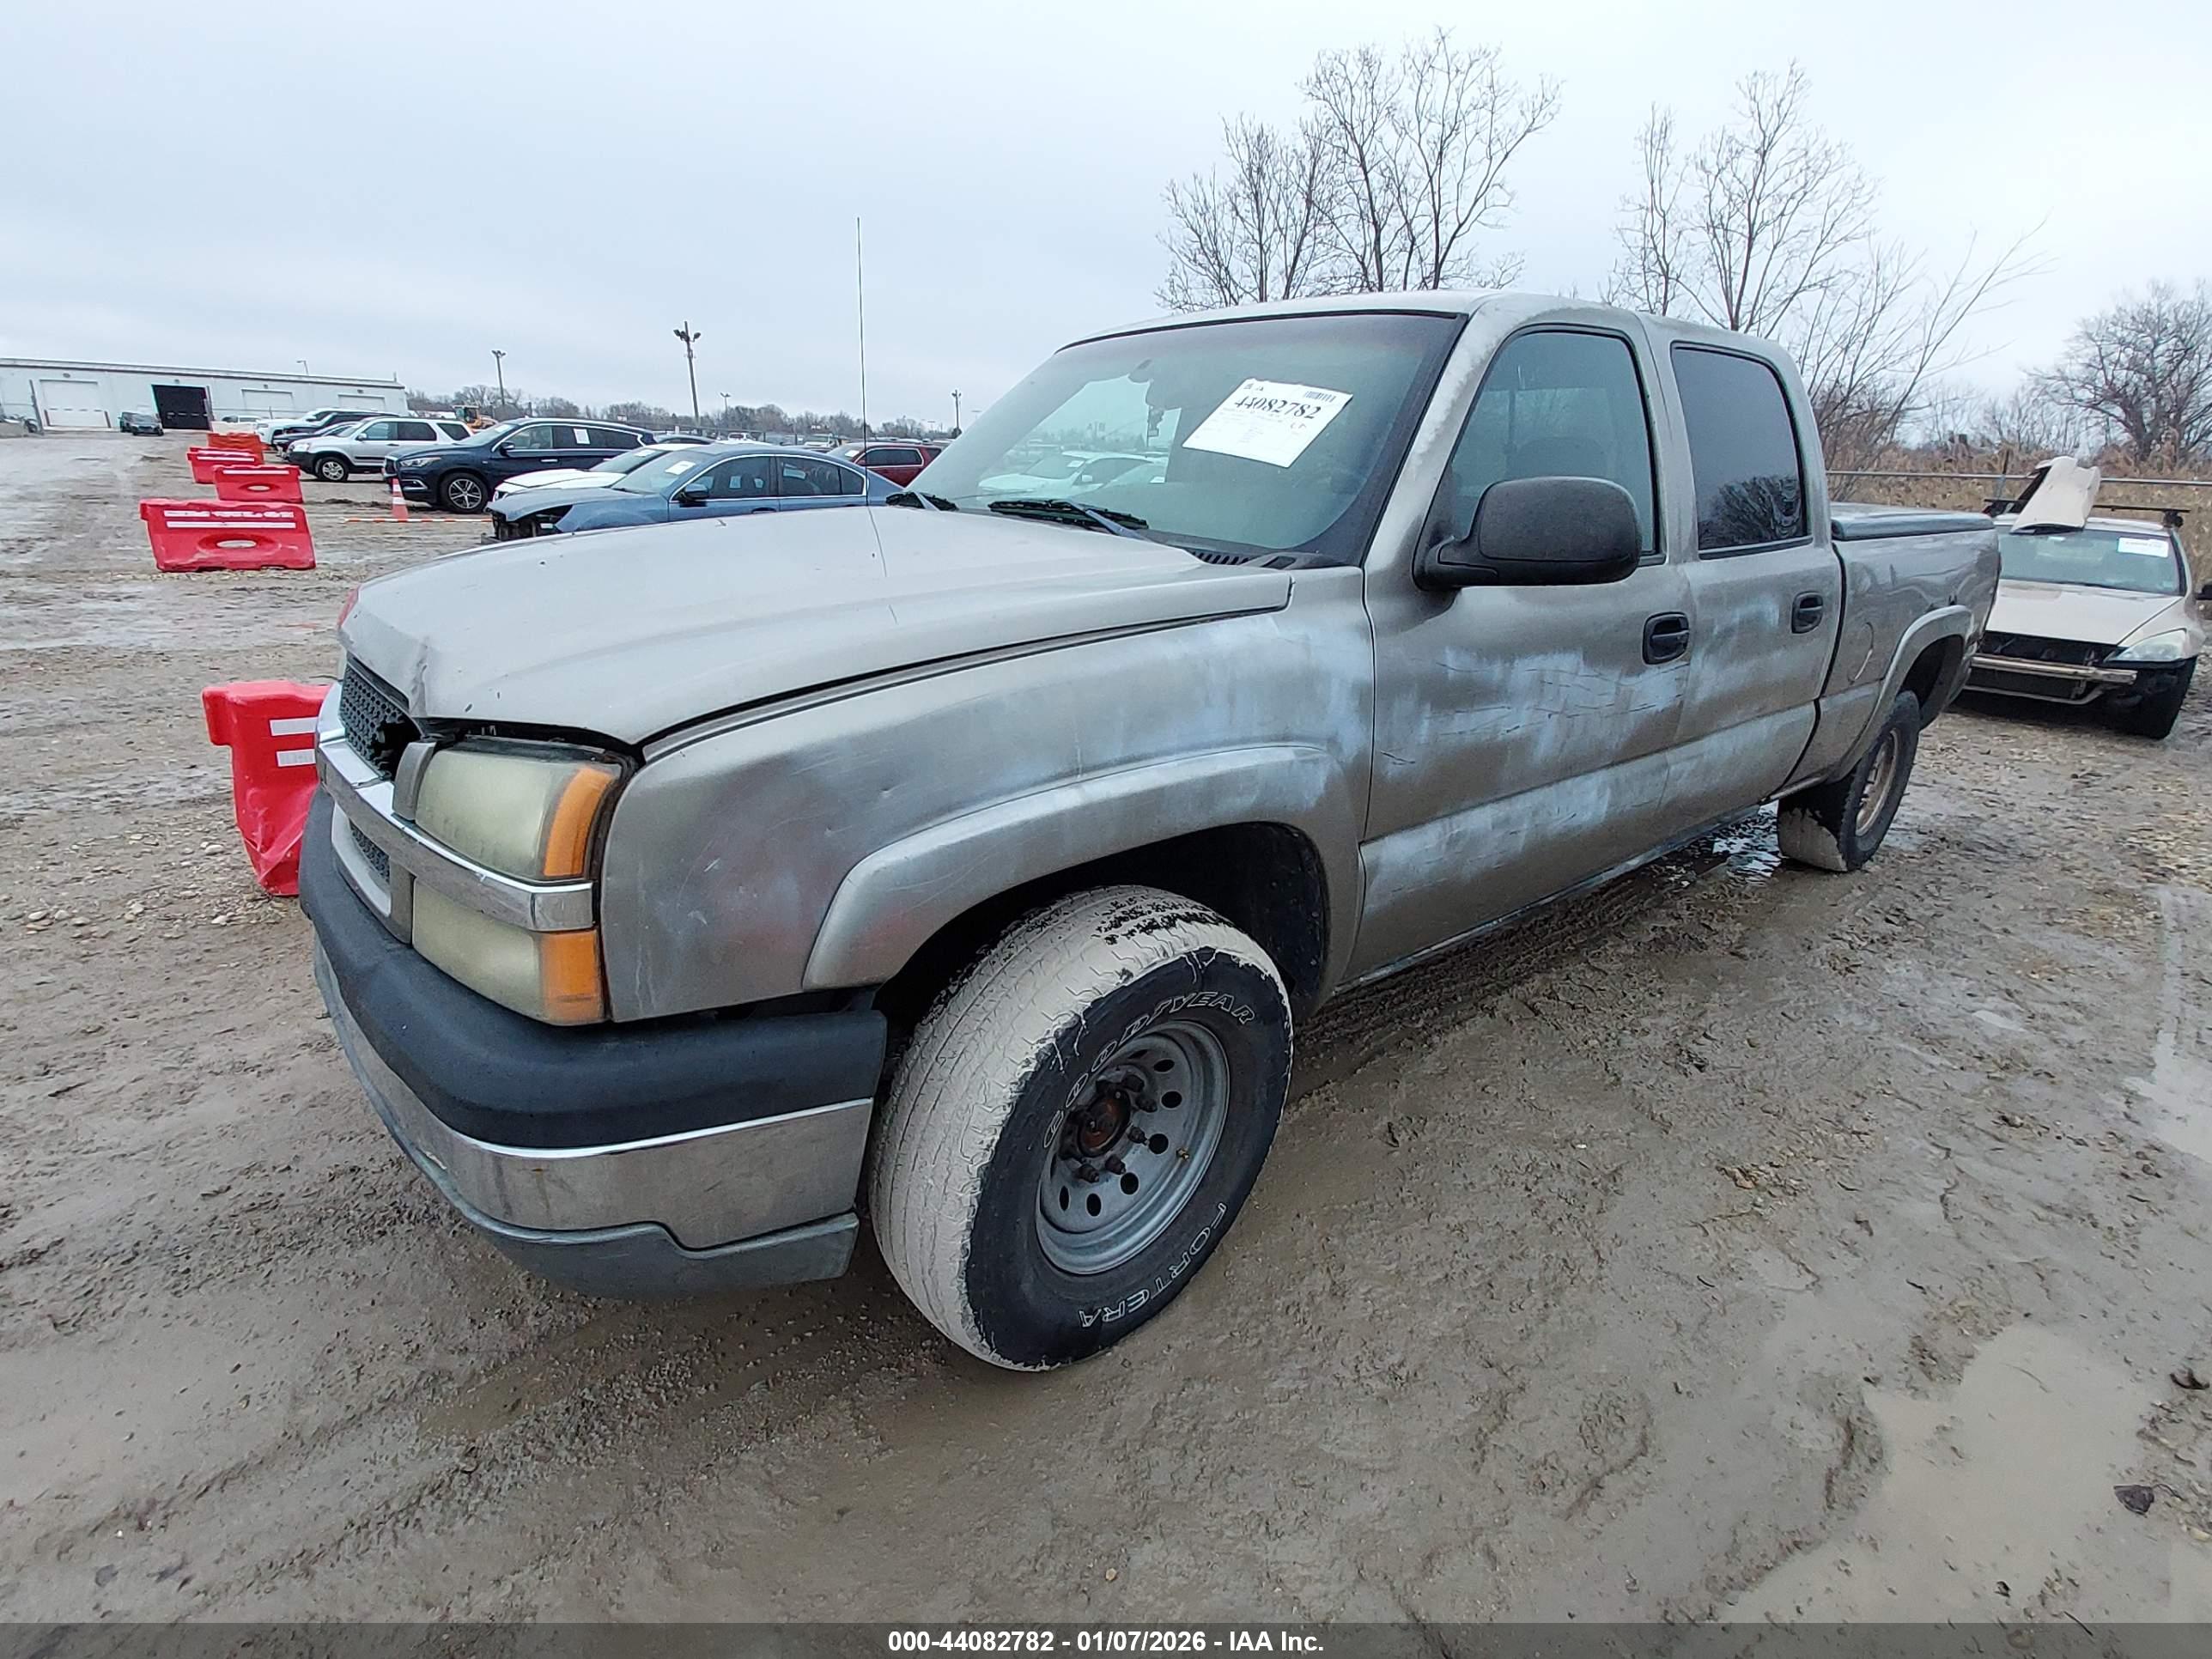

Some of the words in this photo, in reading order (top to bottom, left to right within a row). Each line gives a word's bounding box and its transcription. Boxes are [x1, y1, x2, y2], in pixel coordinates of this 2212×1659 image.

[1234, 395, 1322, 419] 44082782
[1043, 991, 1255, 1149] GOODYEAR
[1079, 1202, 1227, 1328] FORTERA
